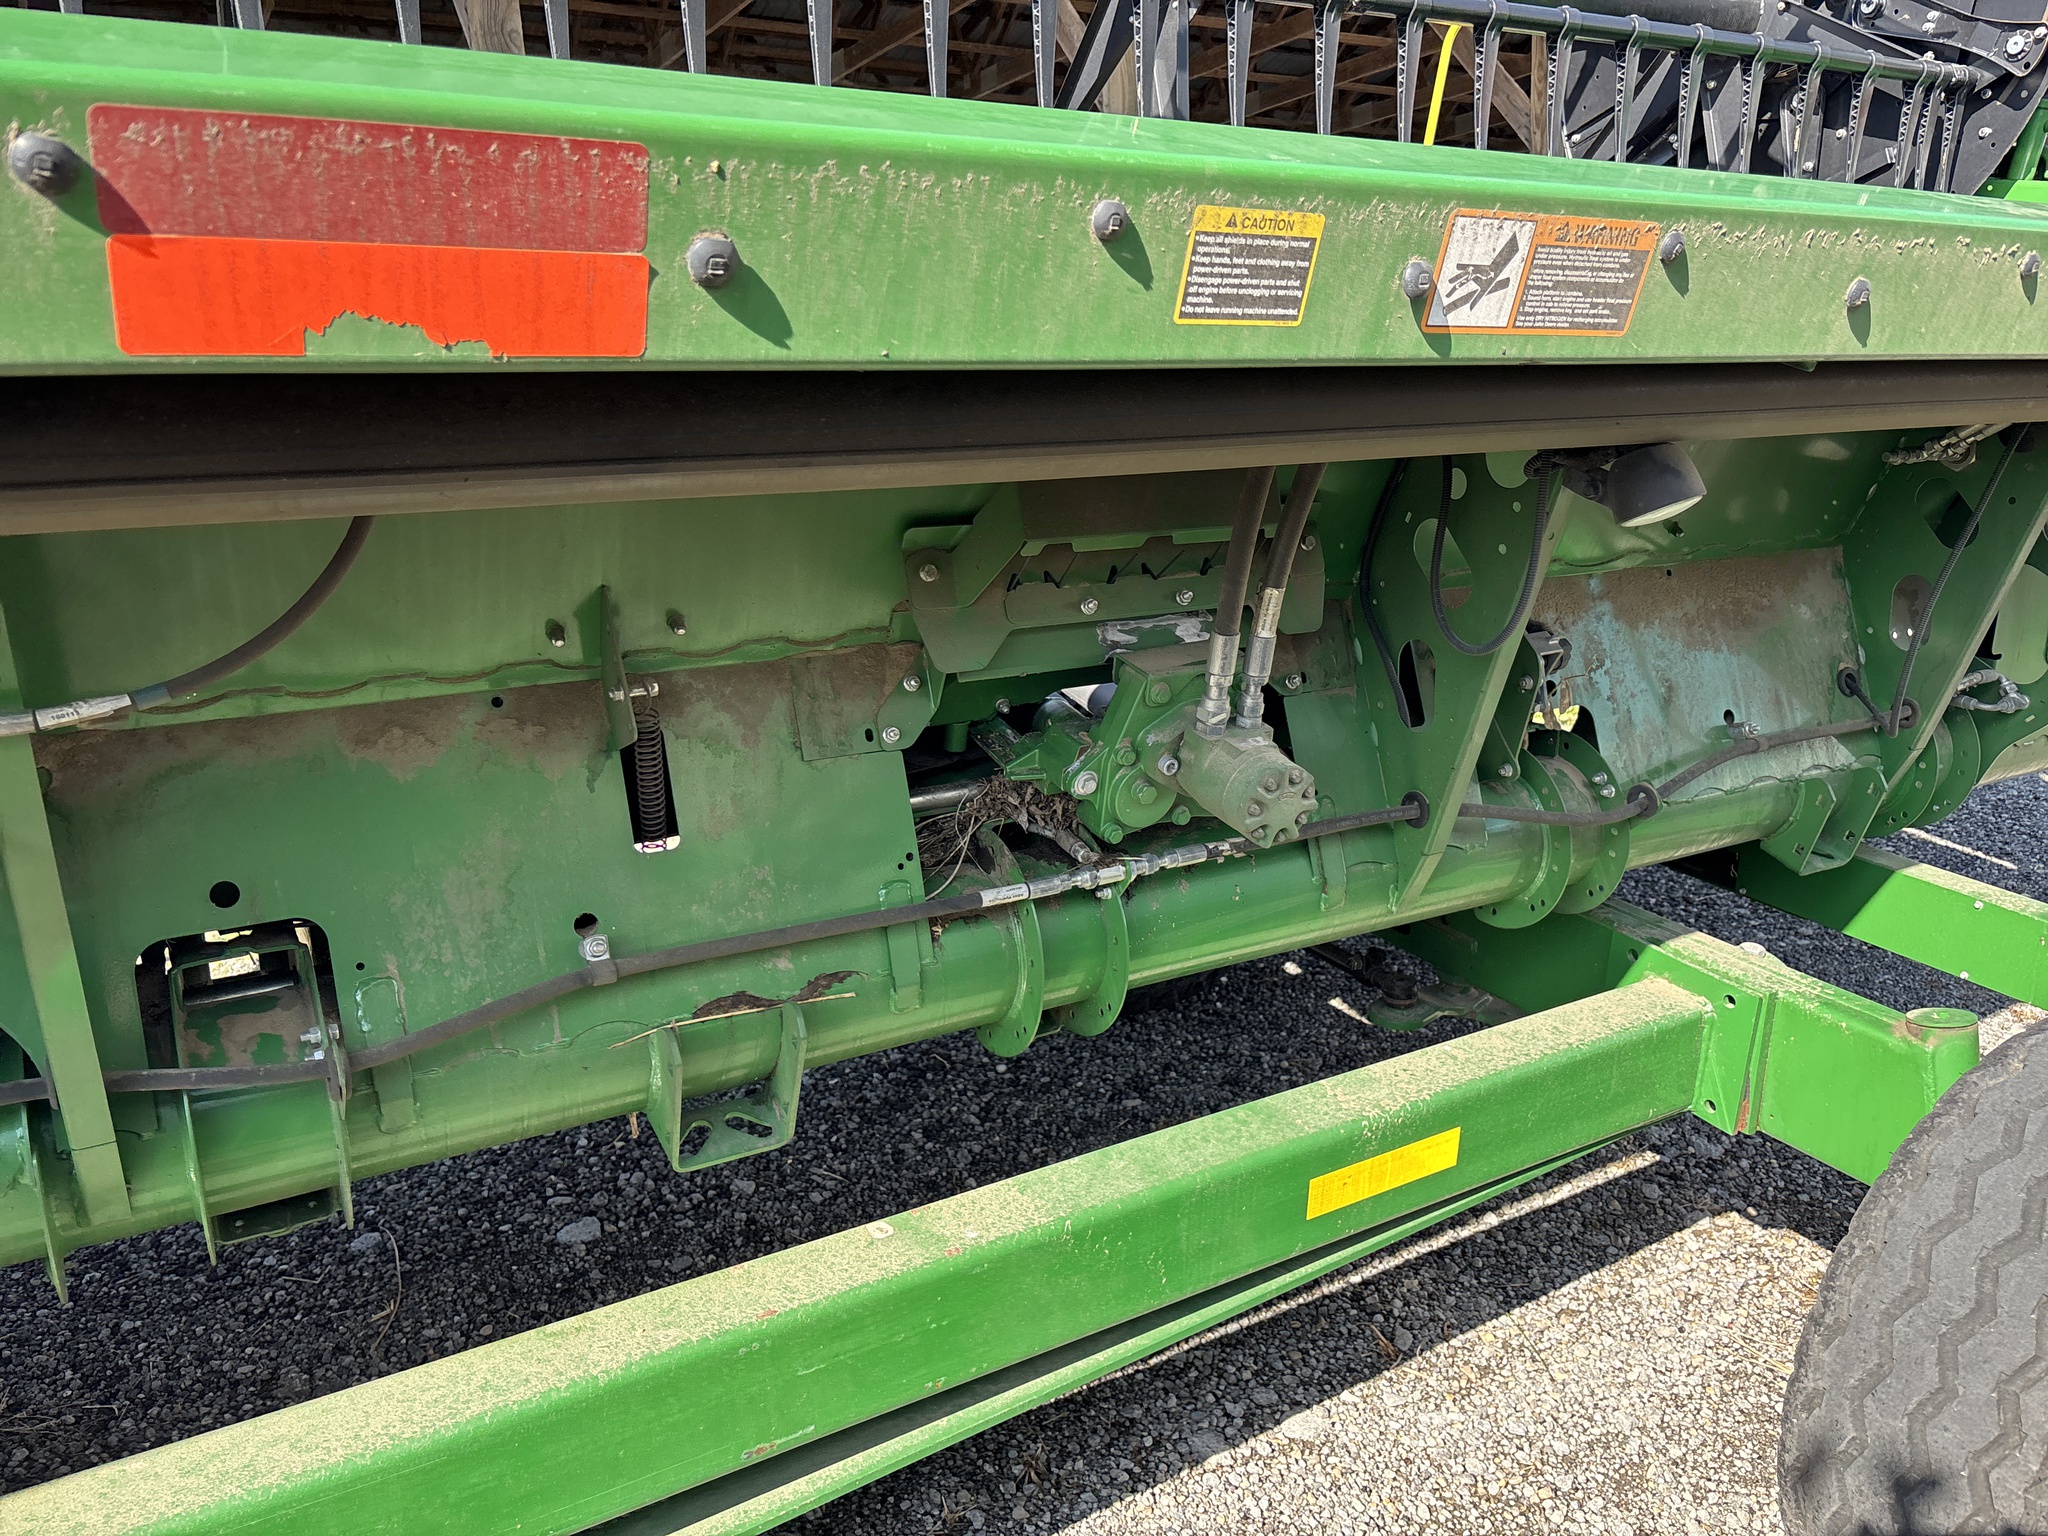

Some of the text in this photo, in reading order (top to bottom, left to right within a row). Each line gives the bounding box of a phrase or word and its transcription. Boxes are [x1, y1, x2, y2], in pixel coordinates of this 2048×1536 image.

[1241, 216, 1295, 232] CAUTION
[1199, 235, 1215, 244] Keep
[1216, 235, 1224, 243] all
[1224, 236, 1246, 244] shields
[1253, 238, 1270, 247] place
[1270, 239, 1289, 248] during
[1575, 224, 1640, 247] WARNING
[1195, 254, 1211, 264] Keep
[1212, 256, 1231, 264] hands,
[1256, 258, 1280, 268] clothing
[1193, 266, 1249, 276] power-driven parts.
[1191, 275, 1222, 286] Disengage
[1222, 277, 1260, 286] power-driven
[1260, 279, 1275, 287] parts
[1189, 285, 1198, 293] off
[1198, 286, 1218, 295] engine
[1219, 286, 1238, 294] before
[1238, 288, 1270, 297] unclogging
[1277, 289, 1302, 298] servicing
[1186, 296, 1213, 304] machine.
[1185, 305, 1195, 314] Do
[1205, 306, 1220, 314] leave
[1221, 307, 1243, 316] running
[1267, 307, 1298, 316] unattended.
